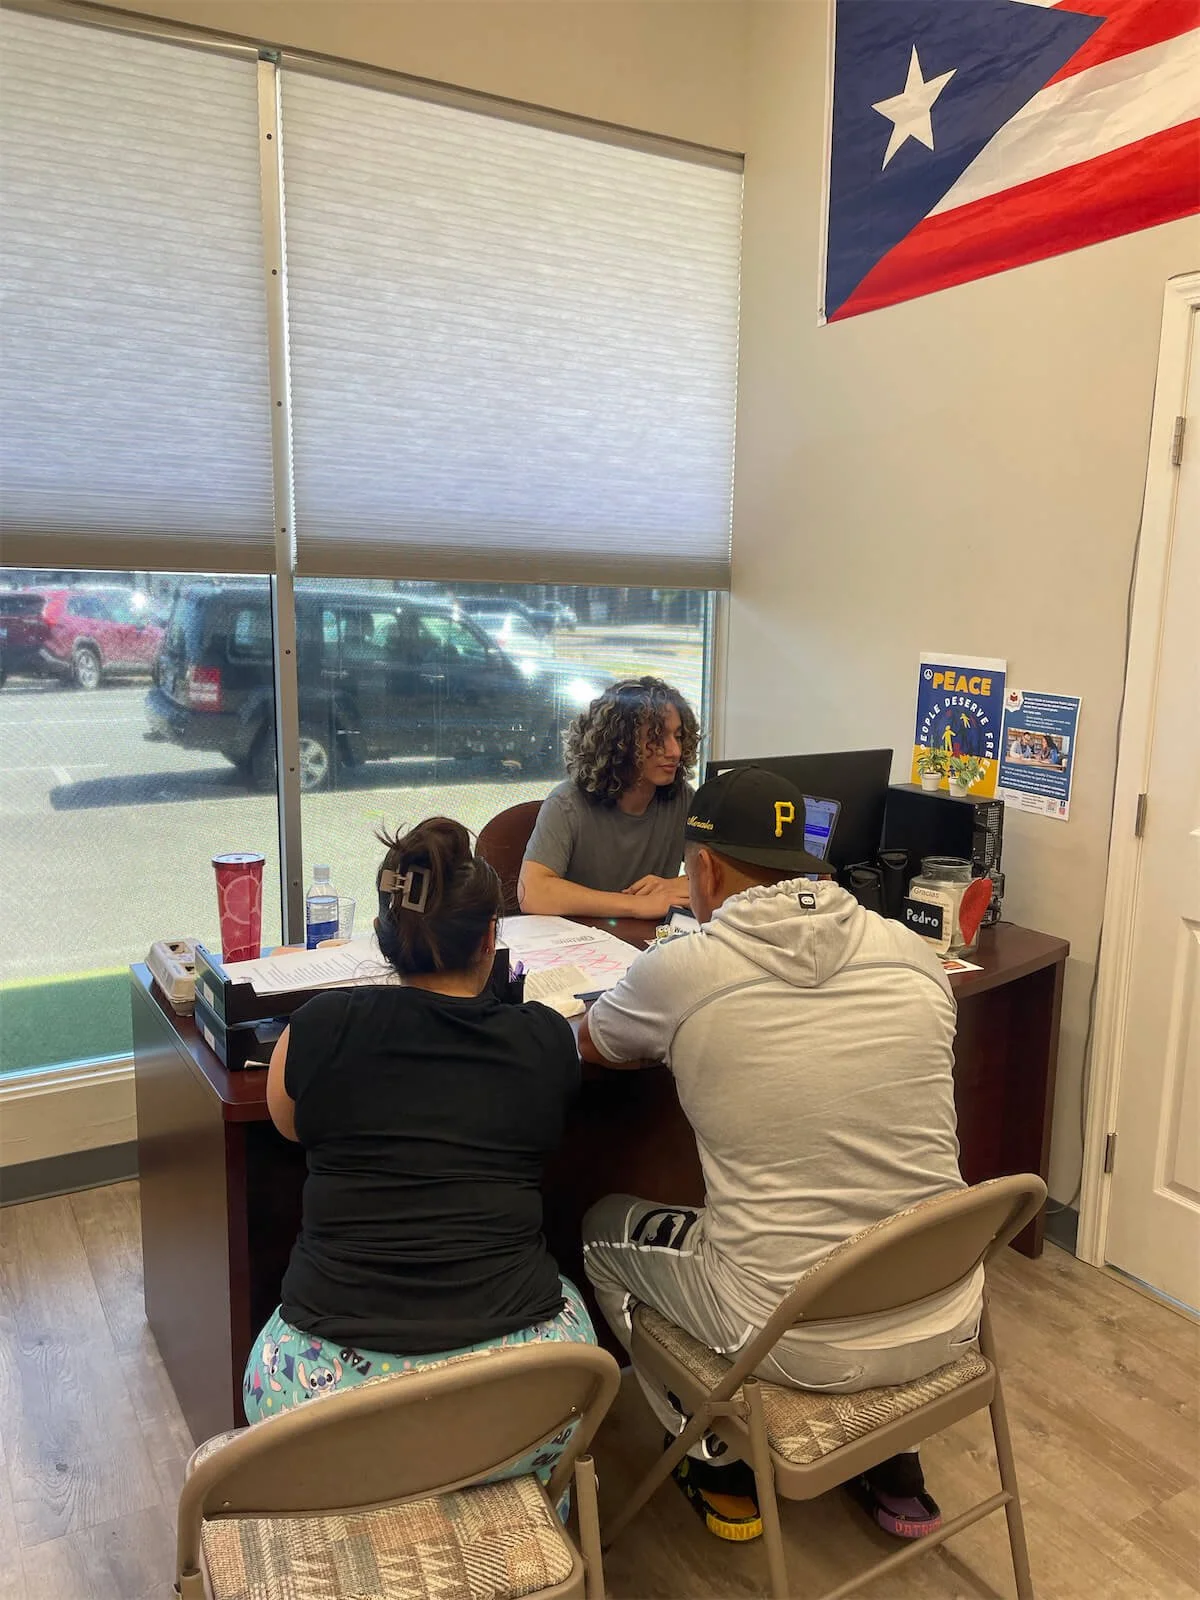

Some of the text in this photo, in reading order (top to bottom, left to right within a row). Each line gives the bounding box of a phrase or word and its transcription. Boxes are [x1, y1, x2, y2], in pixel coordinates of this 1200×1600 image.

[932, 671, 992, 696] PEACE
[944, 696, 989, 726] DESERVE
[774, 801, 795, 837] P
[914, 887, 940, 898] Gracias
[906, 908, 939, 927] Pedro
